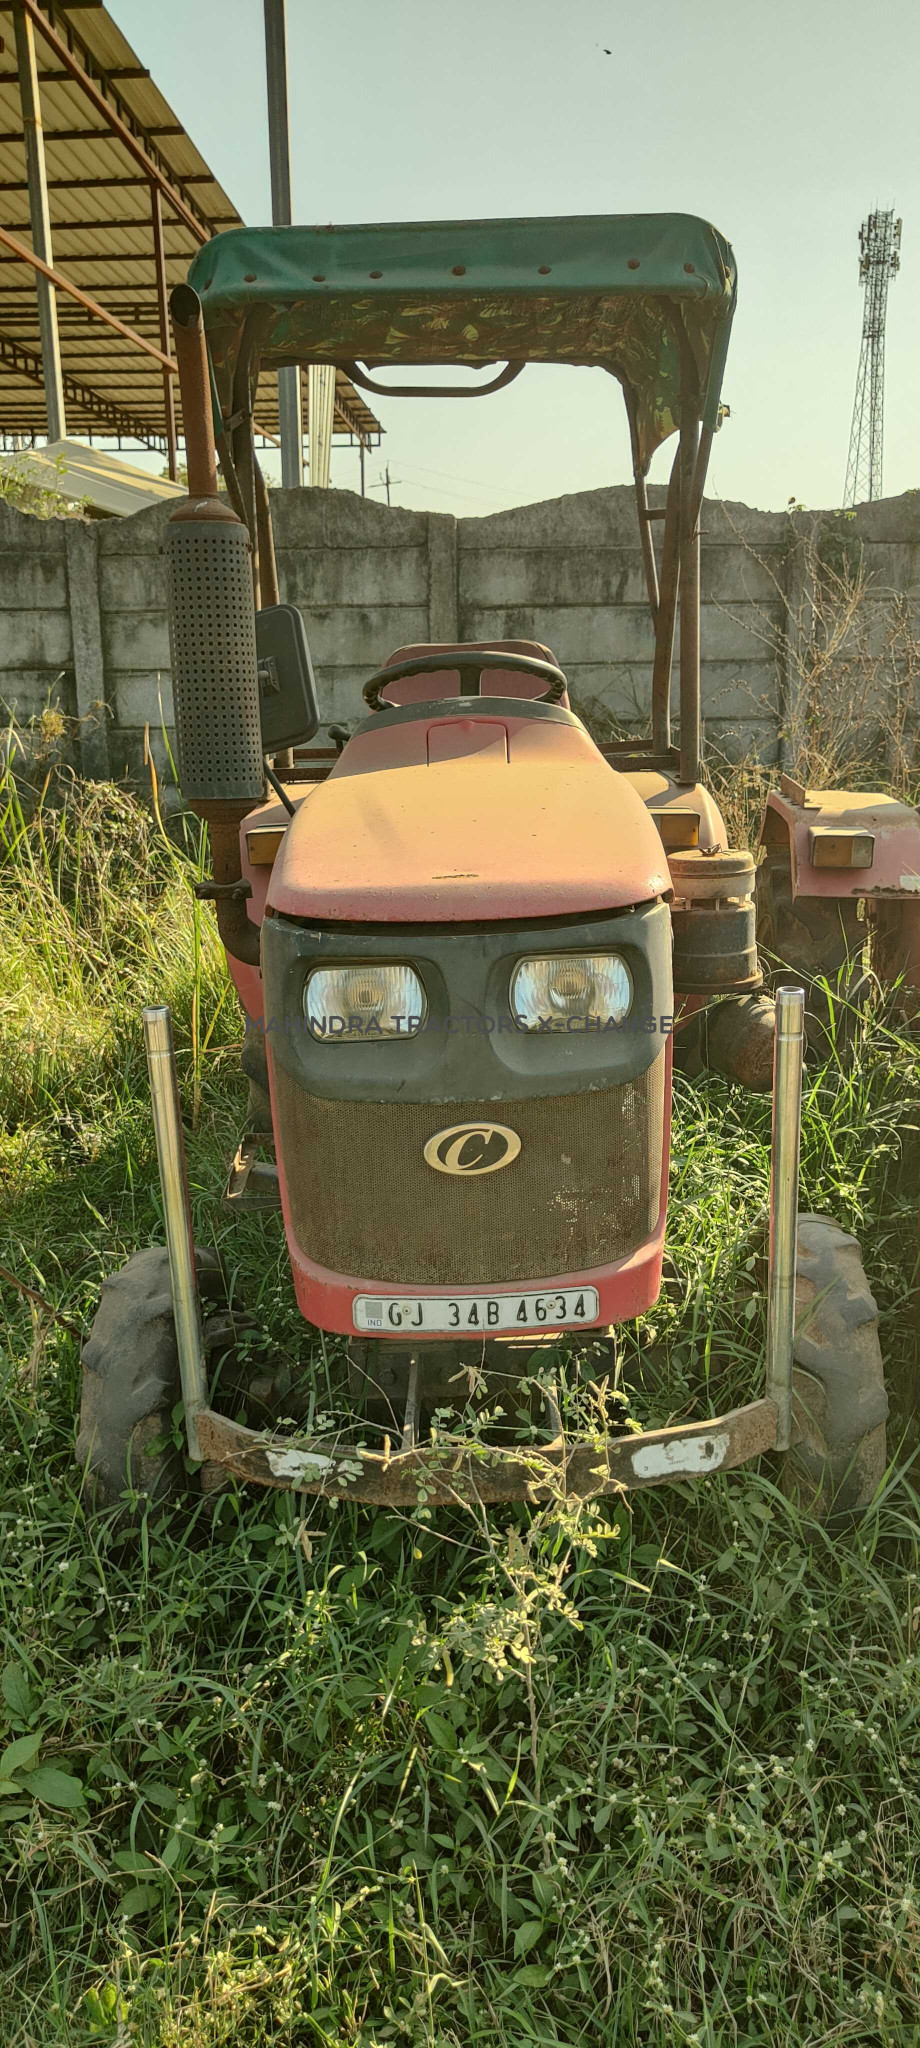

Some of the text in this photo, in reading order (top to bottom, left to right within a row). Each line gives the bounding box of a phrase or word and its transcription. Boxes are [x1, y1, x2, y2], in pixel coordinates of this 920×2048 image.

[388, 1294, 586, 1326] GJ 34B 4634
[367, 1319, 382, 1327] IND
